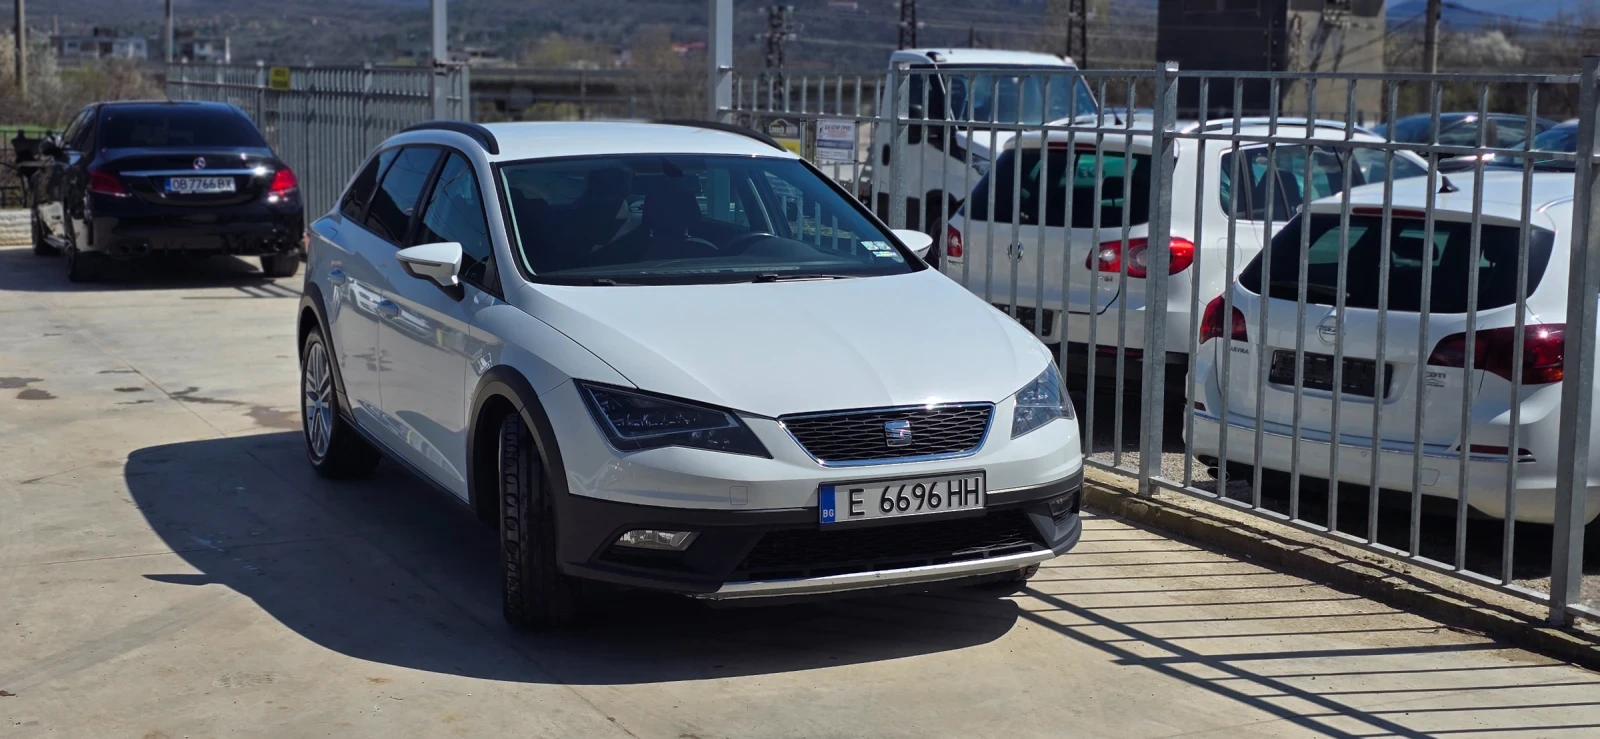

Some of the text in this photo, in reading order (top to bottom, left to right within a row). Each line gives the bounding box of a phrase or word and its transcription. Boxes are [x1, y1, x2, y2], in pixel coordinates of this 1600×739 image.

[849, 477, 980, 516] E 6696 HH
[823, 509, 834, 518] BG
